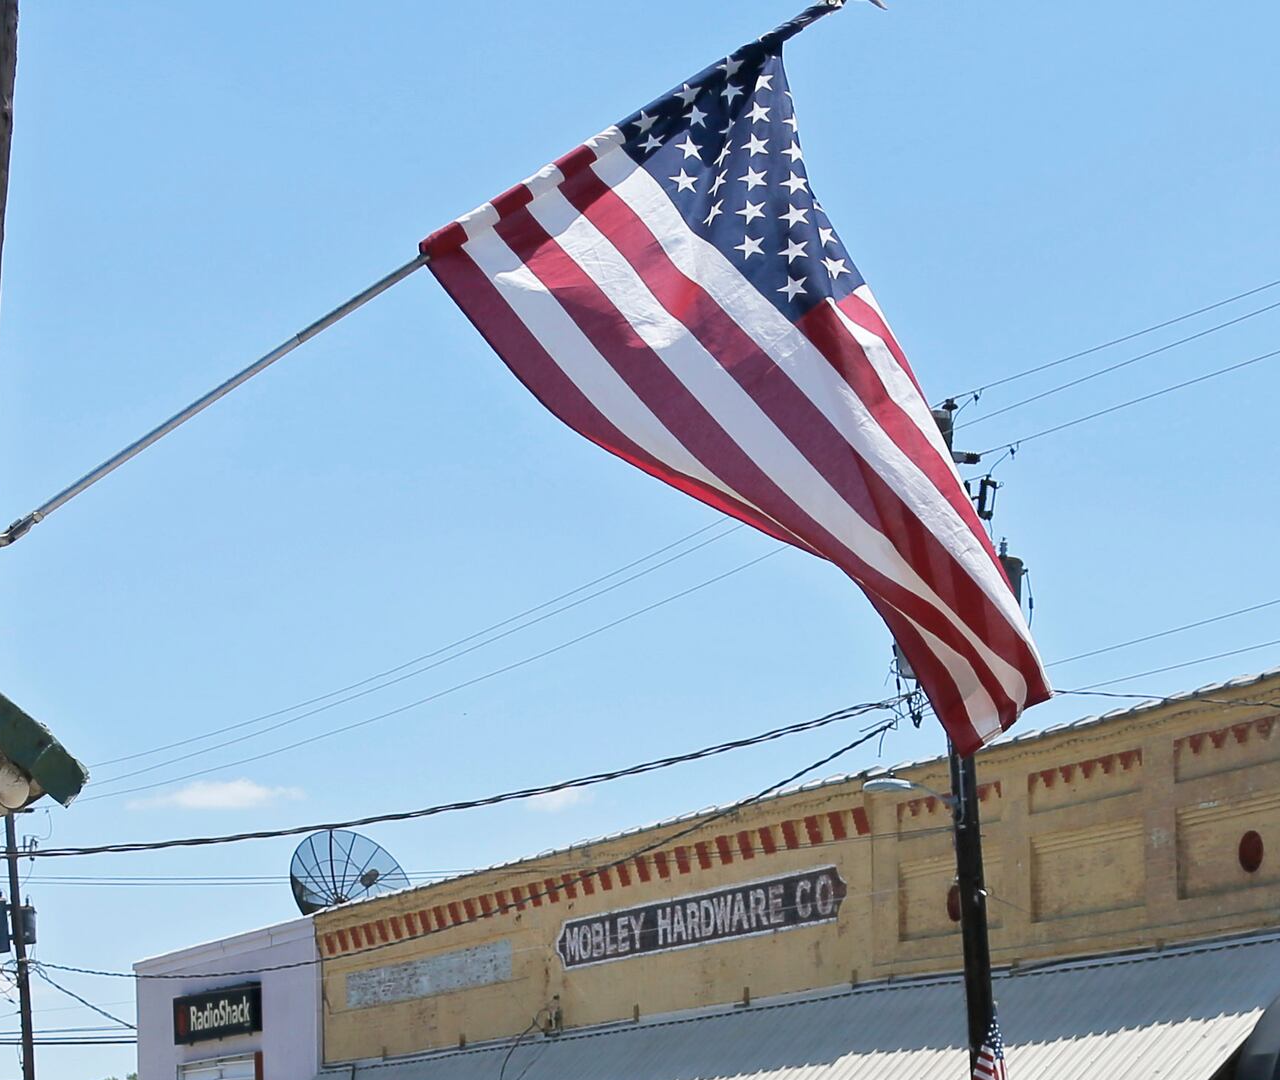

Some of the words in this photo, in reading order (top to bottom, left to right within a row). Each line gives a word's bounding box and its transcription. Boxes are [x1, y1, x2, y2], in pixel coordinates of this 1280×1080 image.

[565, 912, 646, 962] MOBLEY
[657, 883, 785, 946] HARDWARE
[190, 995, 250, 1031] RadioShack
